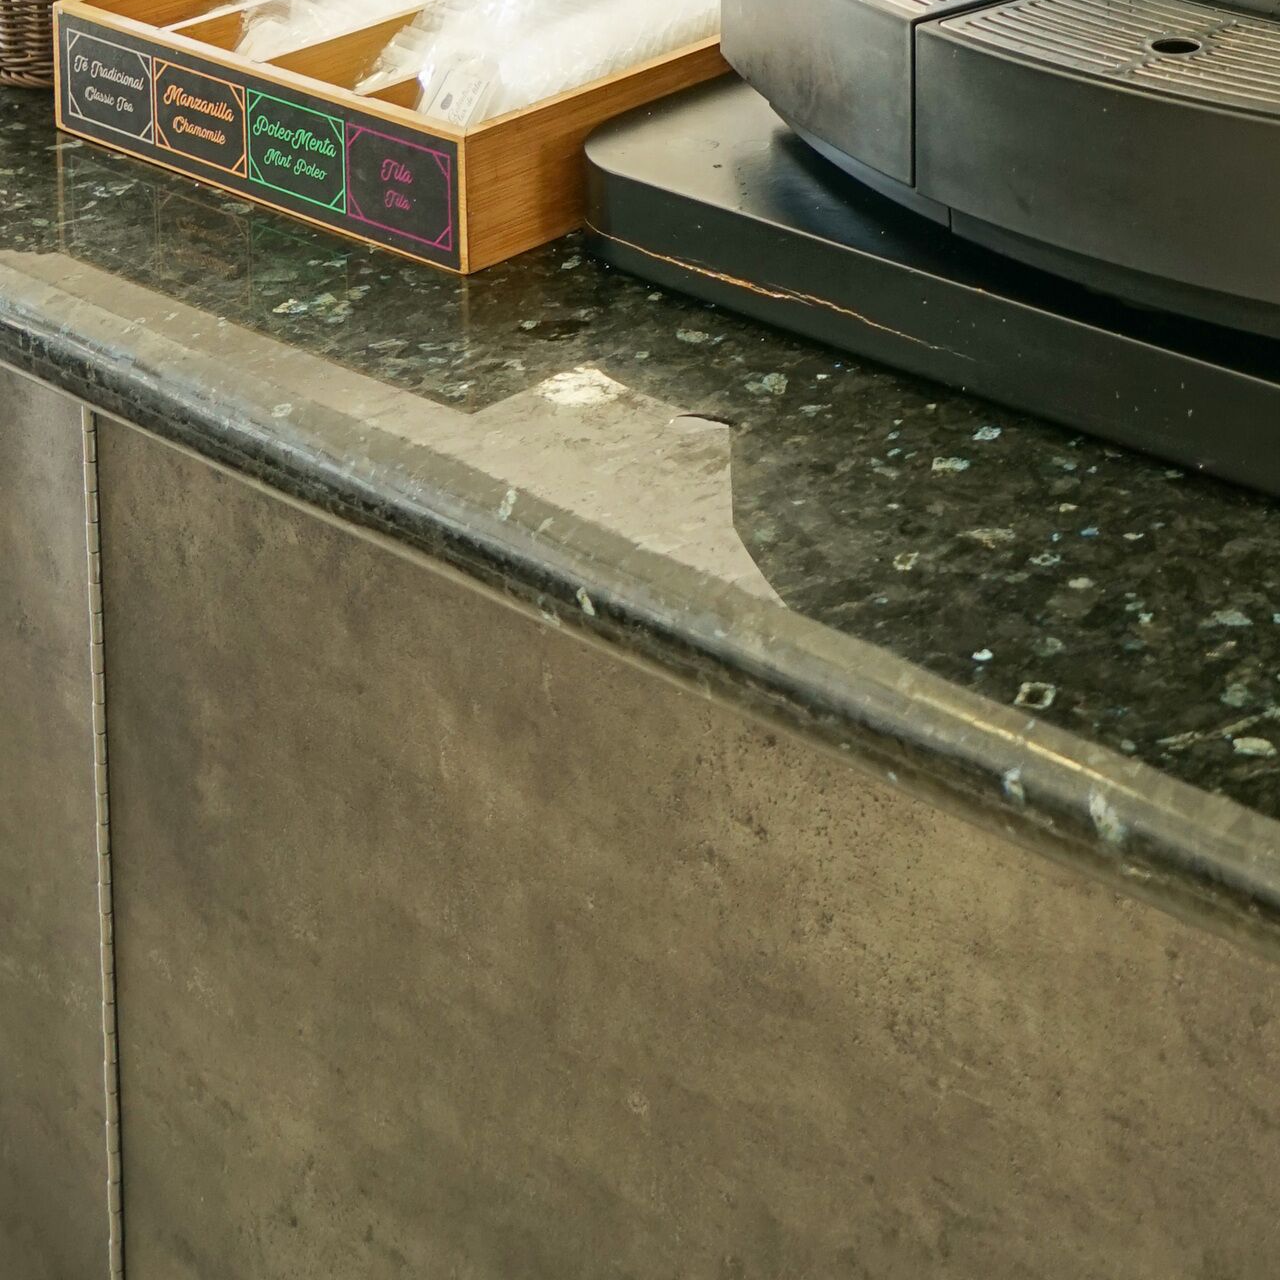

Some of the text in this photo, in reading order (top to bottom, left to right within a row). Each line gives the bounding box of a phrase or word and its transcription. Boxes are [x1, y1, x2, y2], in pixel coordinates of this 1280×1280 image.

[91, 59, 144, 91] Tradicional
[85, 86, 134, 112] Classic Tea
[163, 85, 234, 122] Manzanilla
[173, 116, 226, 145] Chamomile
[264, 148, 327, 181] Mint Poleo
[381, 159, 413, 184] Tila
[384, 190, 411, 211] Tila
